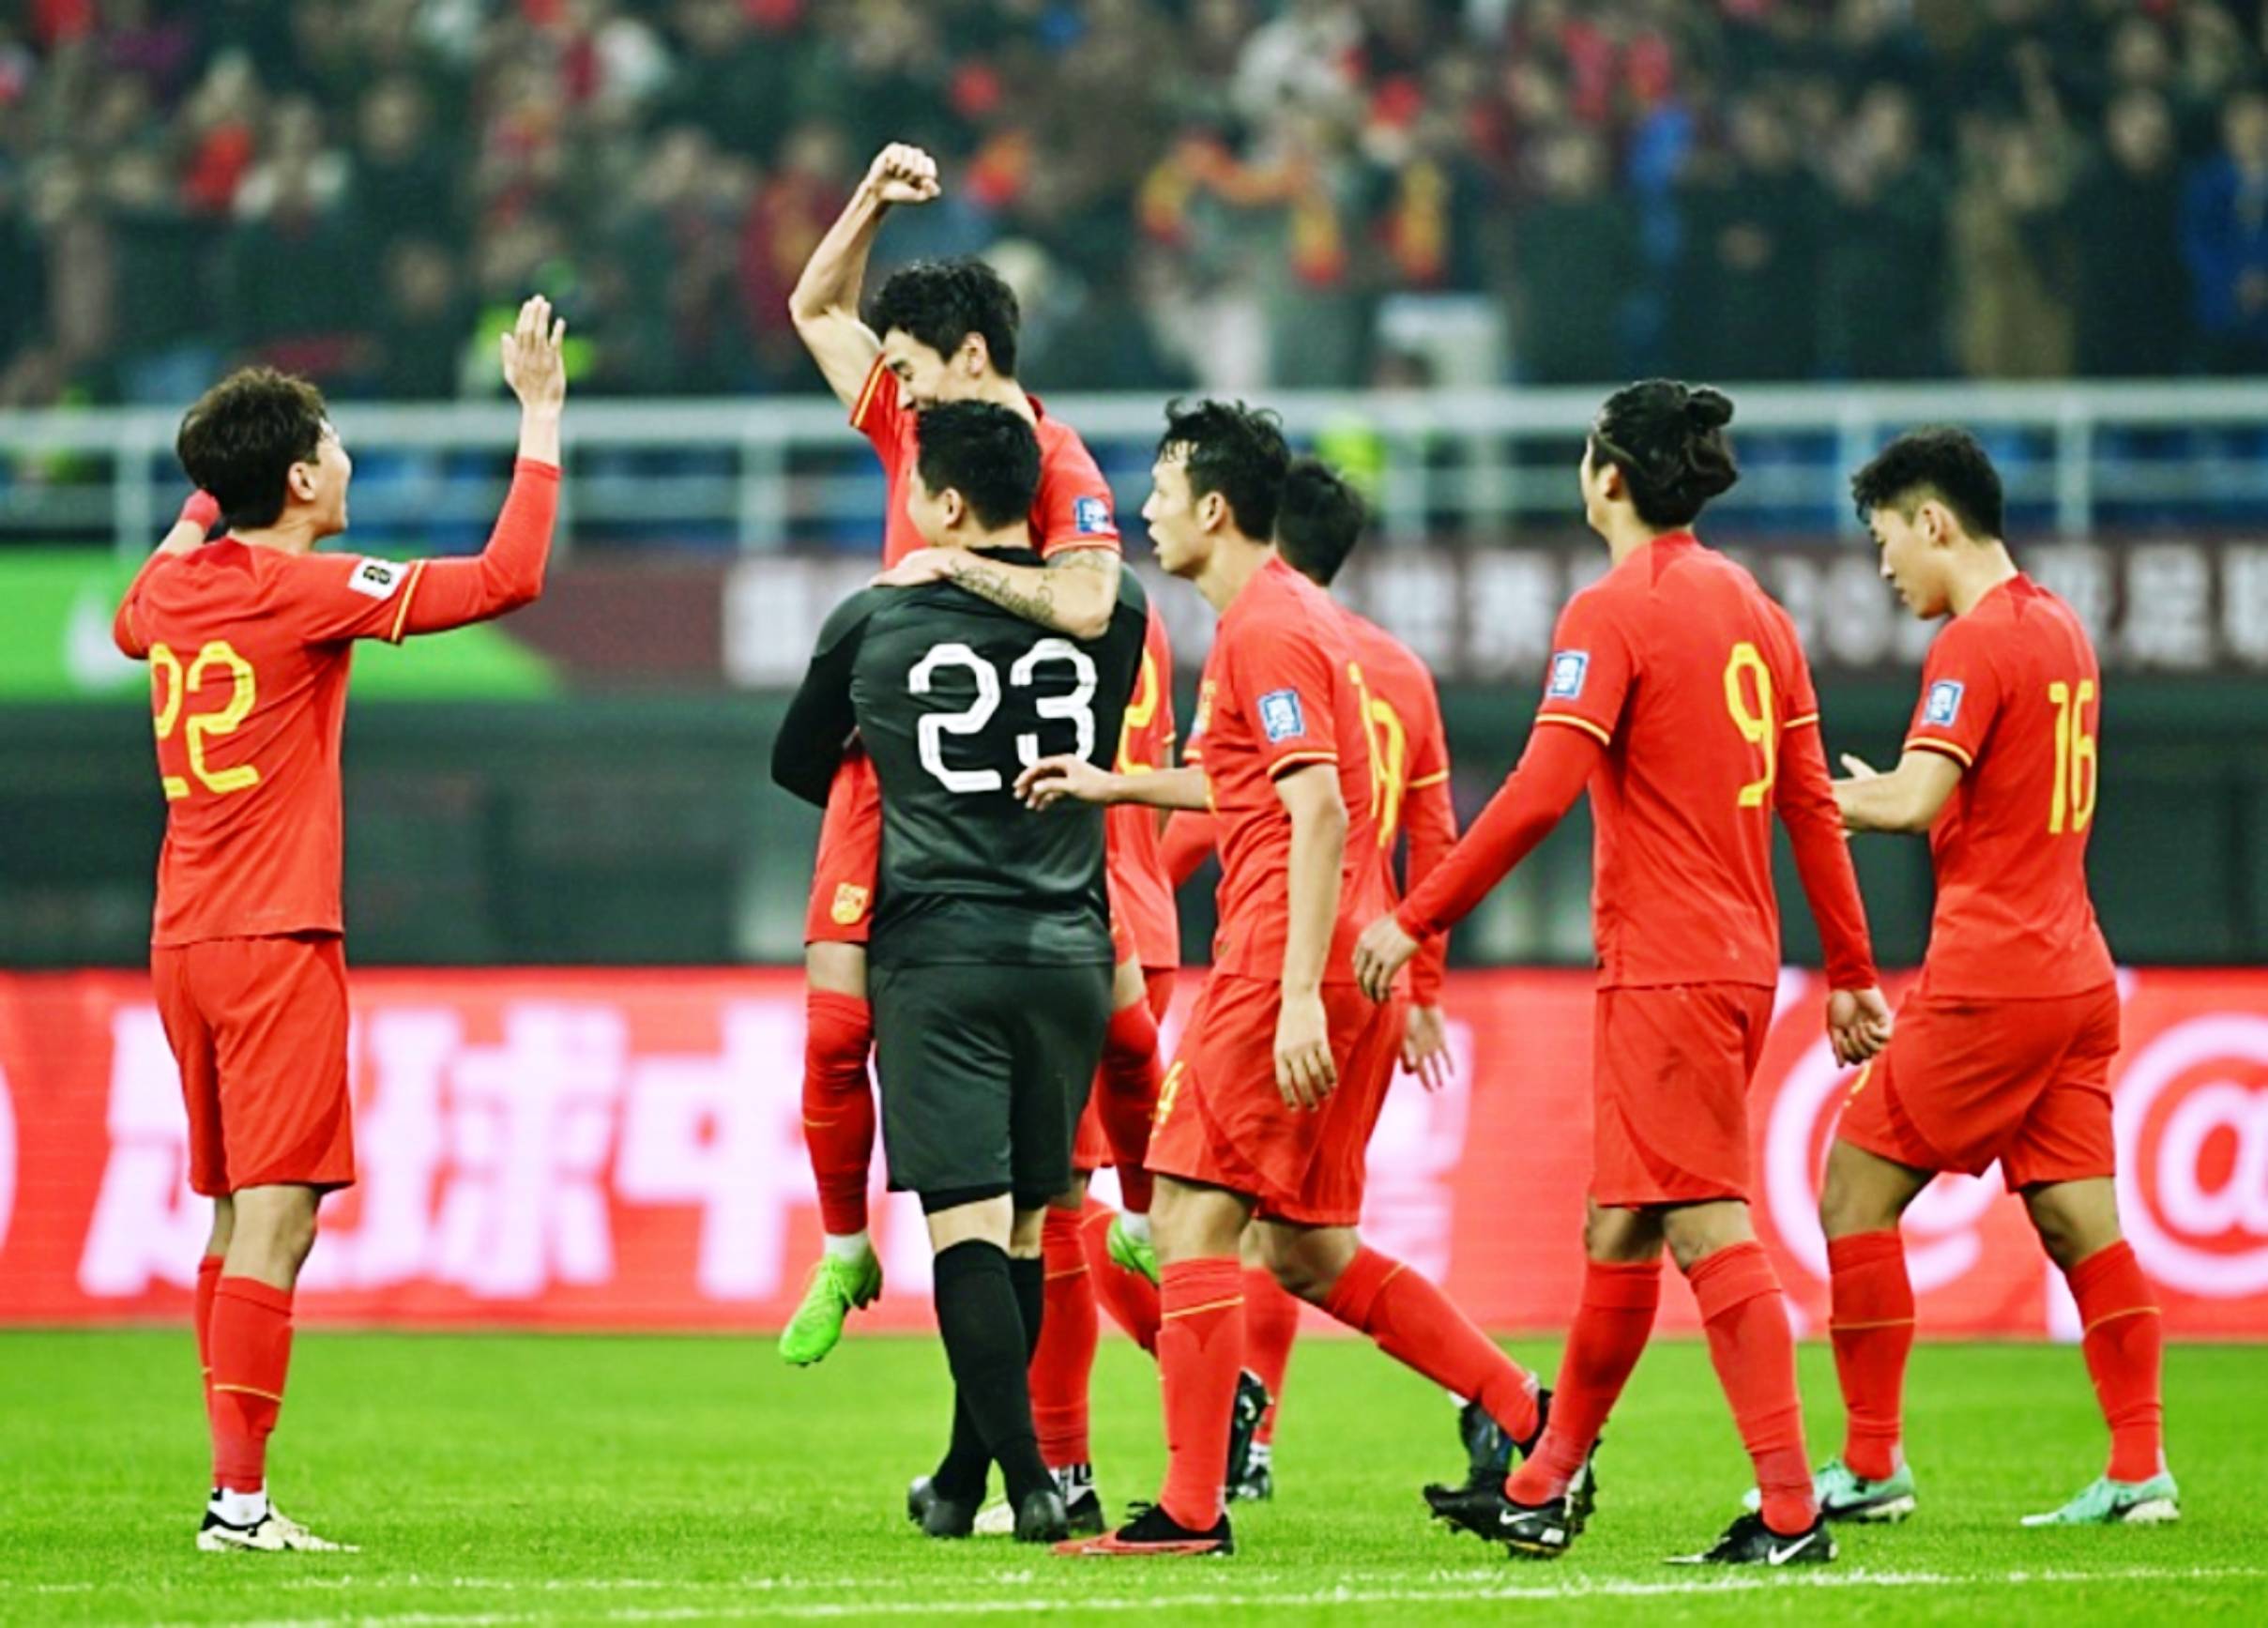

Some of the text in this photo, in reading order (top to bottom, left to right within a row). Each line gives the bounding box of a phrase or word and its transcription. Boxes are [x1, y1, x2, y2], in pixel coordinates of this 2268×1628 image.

[149, 640, 259, 799] 22
[908, 638, 1098, 793] 23
[1724, 641, 1775, 807] 9
[2048, 679, 2097, 834] 16
